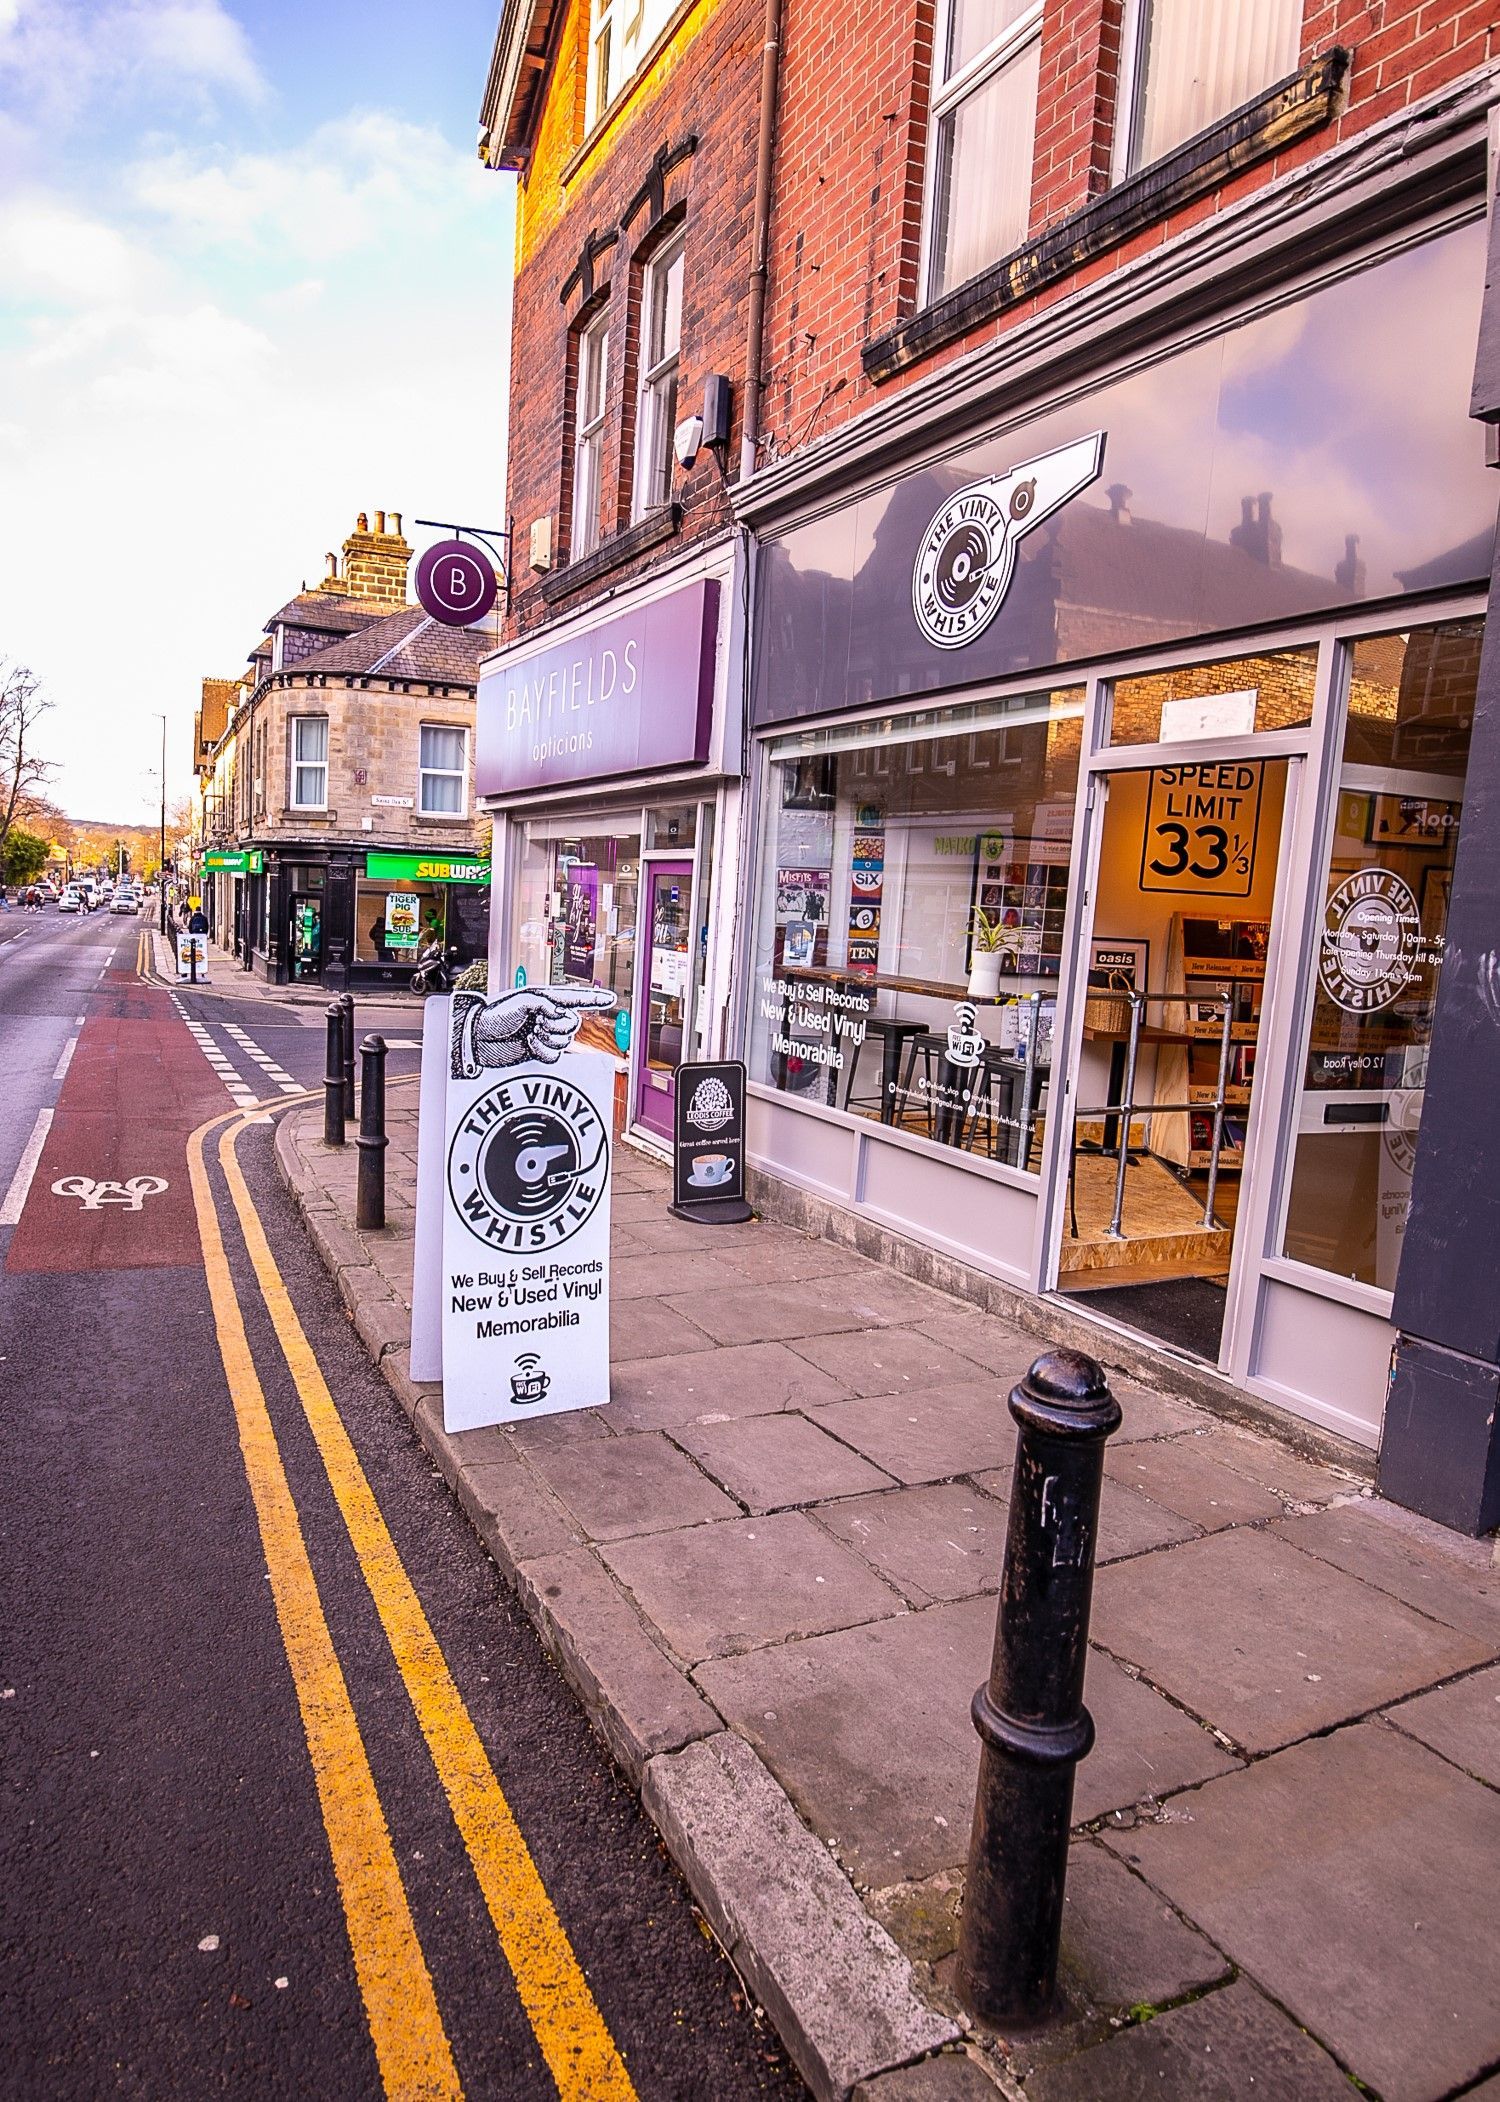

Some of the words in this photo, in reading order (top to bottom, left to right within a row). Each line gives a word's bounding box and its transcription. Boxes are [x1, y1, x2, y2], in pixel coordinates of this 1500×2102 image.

[928, 512, 954, 555] THE
[959, 500, 1001, 537] VINYL
[451, 568, 466, 596] B
[924, 575, 999, 634] WHISTLE
[507, 640, 638, 732] BAYFIELDS
[532, 729, 593, 768] opticians
[1160, 765, 1255, 791] SPEED
[1166, 793, 1243, 821] LIMIT
[207, 857, 243, 866] SUBWAY
[415, 863, 491, 879] SUBWAY
[389, 895, 417, 904] TIGER
[395, 903, 411, 912] PIG
[392, 925, 412, 933] SUB
[1357, 912, 1393, 925] Opening
[1395, 913, 1420, 924] Times
[1322, 928, 1355, 941] Monday
[1361, 930, 1399, 944] Saturday
[1402, 933, 1427, 944] 10am
[851, 947, 876, 959] TEN
[1098, 952, 1133, 964] oasis
[1340, 949, 1373, 961] opening
[1375, 950, 1413, 964] Thursday
[1415, 953, 1426, 963] till
[1191, 962, 1205, 971] New
[1205, 963, 1232, 972] Releases
[1340, 965, 1372, 979] Sunday
[1374, 968, 1395, 979] 11am
[1402, 971, 1422, 982] 4pm
[762, 976, 776, 994] We
[777, 979, 796, 1002] Buy
[797, 983, 804, 1000] &
[805, 984, 825, 1003] Sell
[825, 986, 870, 1012] Records
[760, 998, 786, 1022] New
[787, 1004, 796, 1025] &
[798, 1006, 831, 1033] Used
[833, 1013, 866, 1046] Vinyl
[771, 1032, 844, 1070] Memorabilia
[463, 1088, 514, 1137] THE
[522, 1083, 595, 1138] VINYL
[687, 1111, 710, 1120] LEODIS
[710, 1109, 733, 1118] COFFEE
[463, 1183, 597, 1247] WHISTLE
[451, 1273, 474, 1289] We
[478, 1272, 505, 1288] Buy
[509, 1269, 518, 1283] &
[522, 1265, 546, 1281] Sell
[549, 1259, 603, 1279] Records
[452, 1295, 493, 1313] New
[498, 1290, 509, 1308] &
[514, 1284, 558, 1306] Used
[563, 1278, 602, 1301] Vinyl
[476, 1309, 580, 1339] Memorabilia
